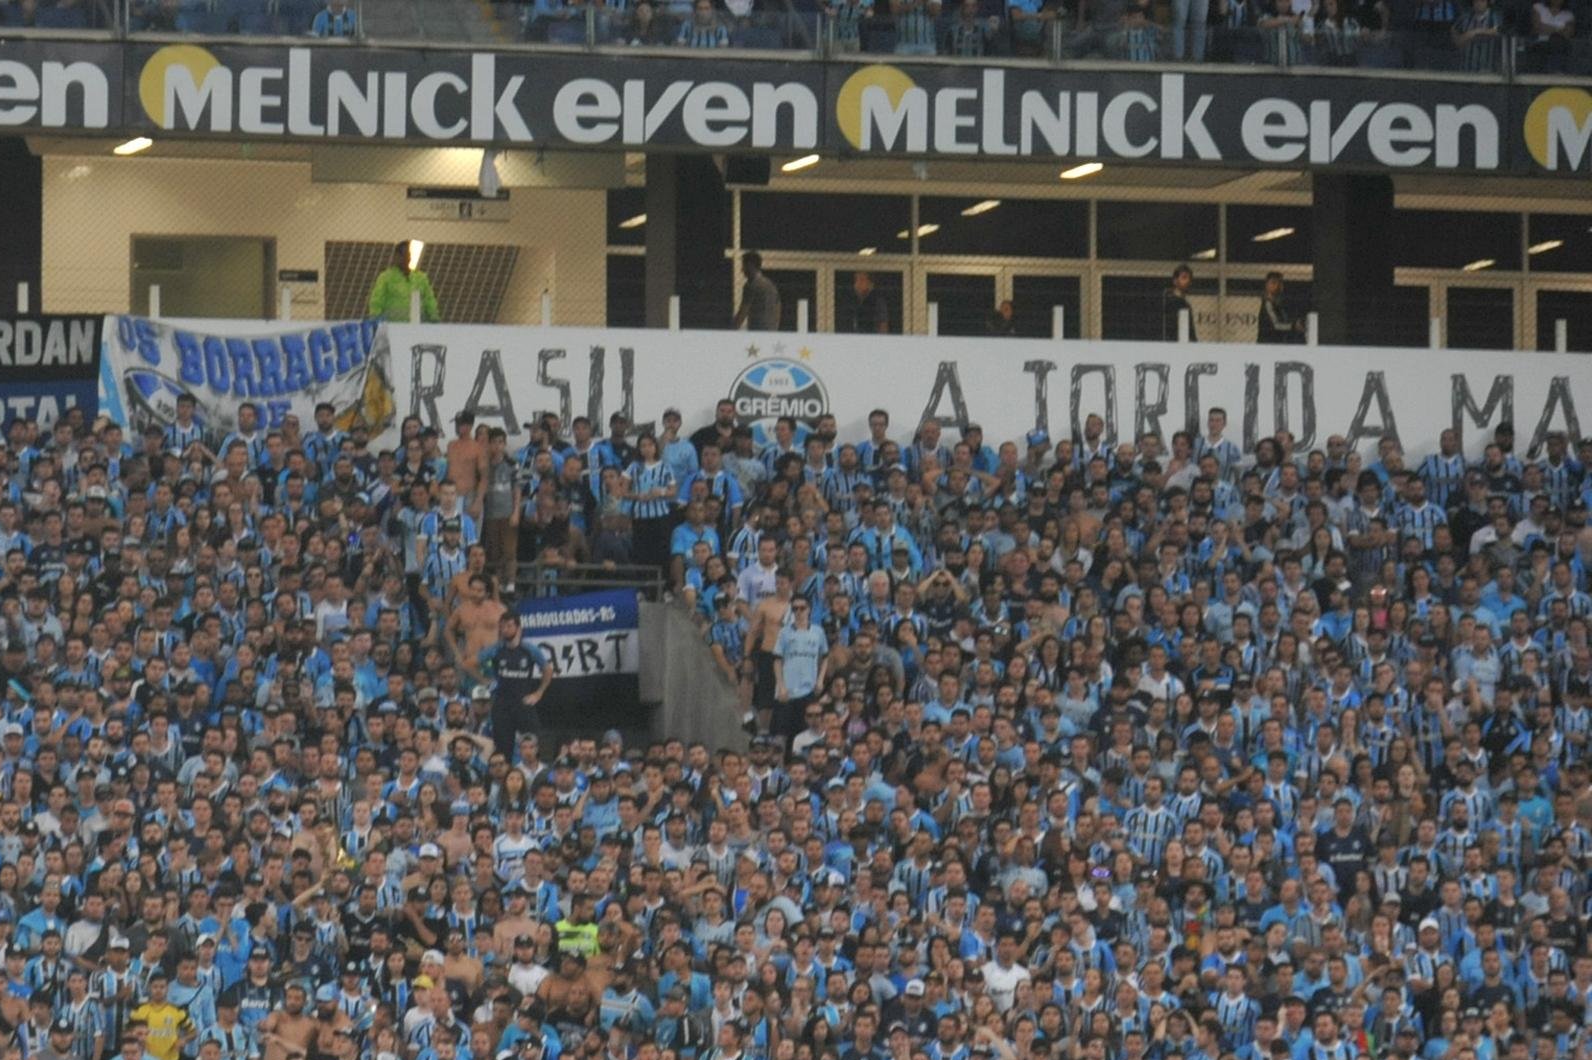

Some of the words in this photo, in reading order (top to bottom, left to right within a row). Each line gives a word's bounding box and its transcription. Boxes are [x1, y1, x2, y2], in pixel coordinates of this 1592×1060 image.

[554, 77, 818, 150] even
[1241, 99, 1500, 169] even
[117, 315, 161, 366] OS
